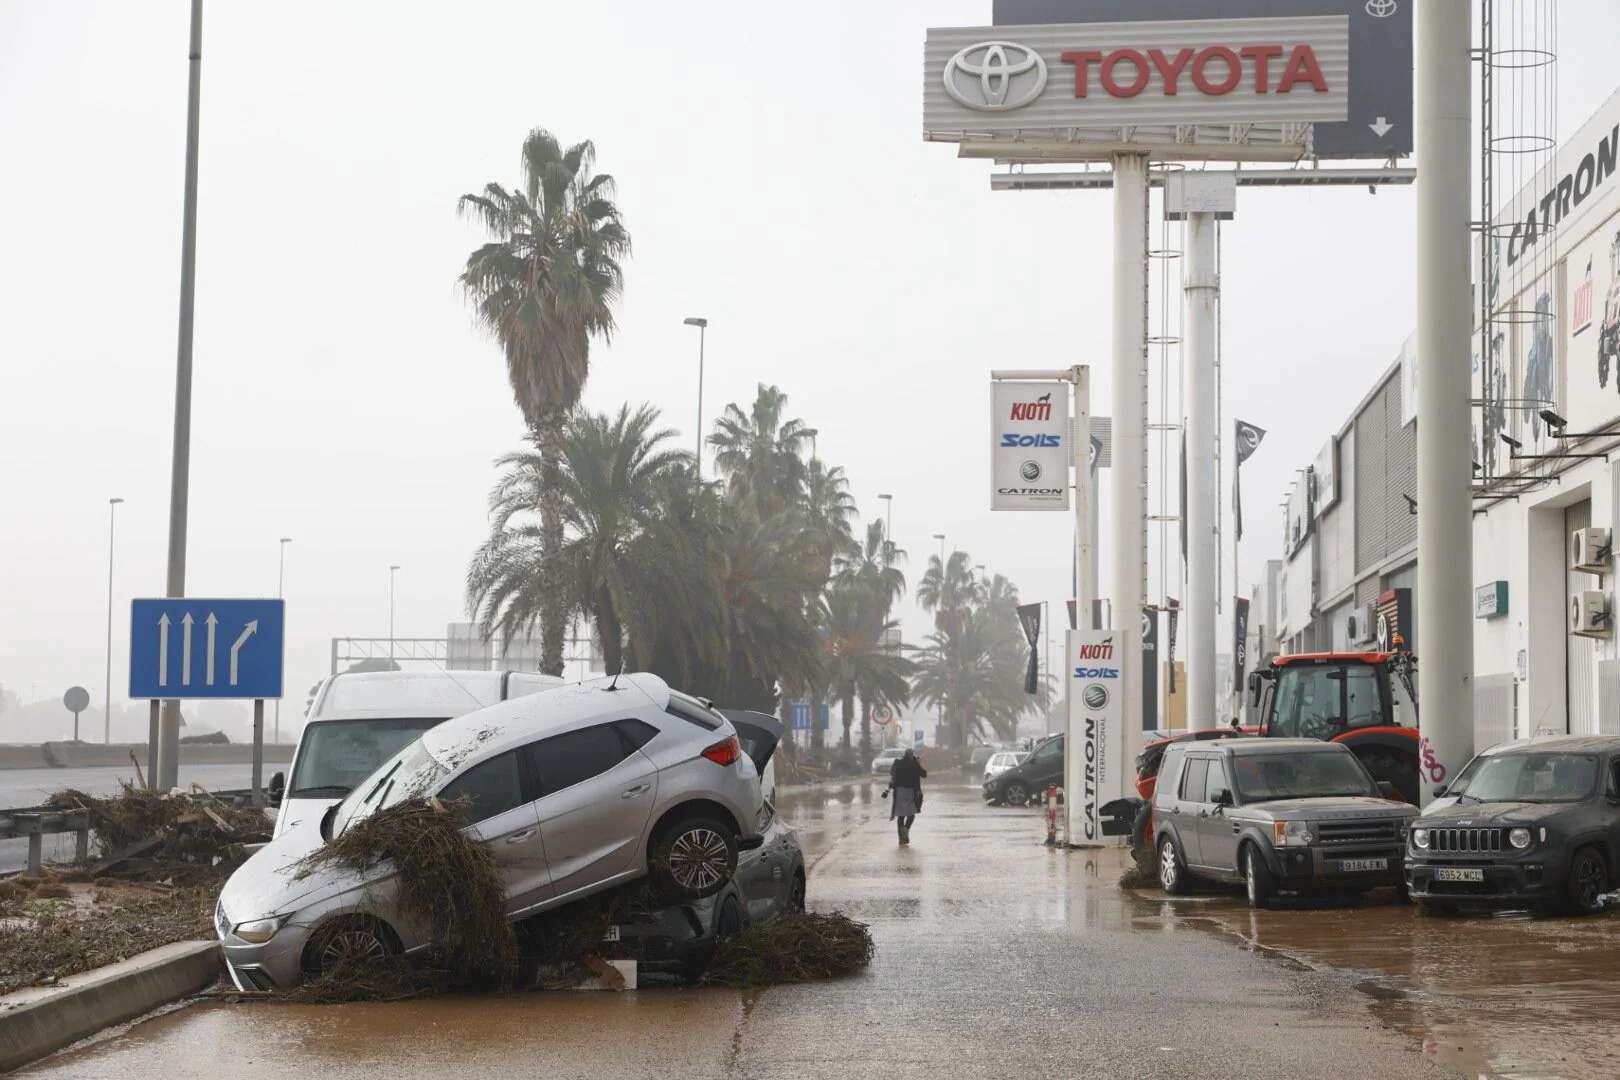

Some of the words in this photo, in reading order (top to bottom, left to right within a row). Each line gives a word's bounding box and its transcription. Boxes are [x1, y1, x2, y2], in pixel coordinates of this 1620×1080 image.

[1061, 44, 1329, 99] TOYOTA
[1507, 124, 1620, 267] CATRON
[1010, 403, 1051, 420] KIOTI
[1080, 644, 1112, 659] KIOTI
[1085, 717, 1095, 840] CATRON
